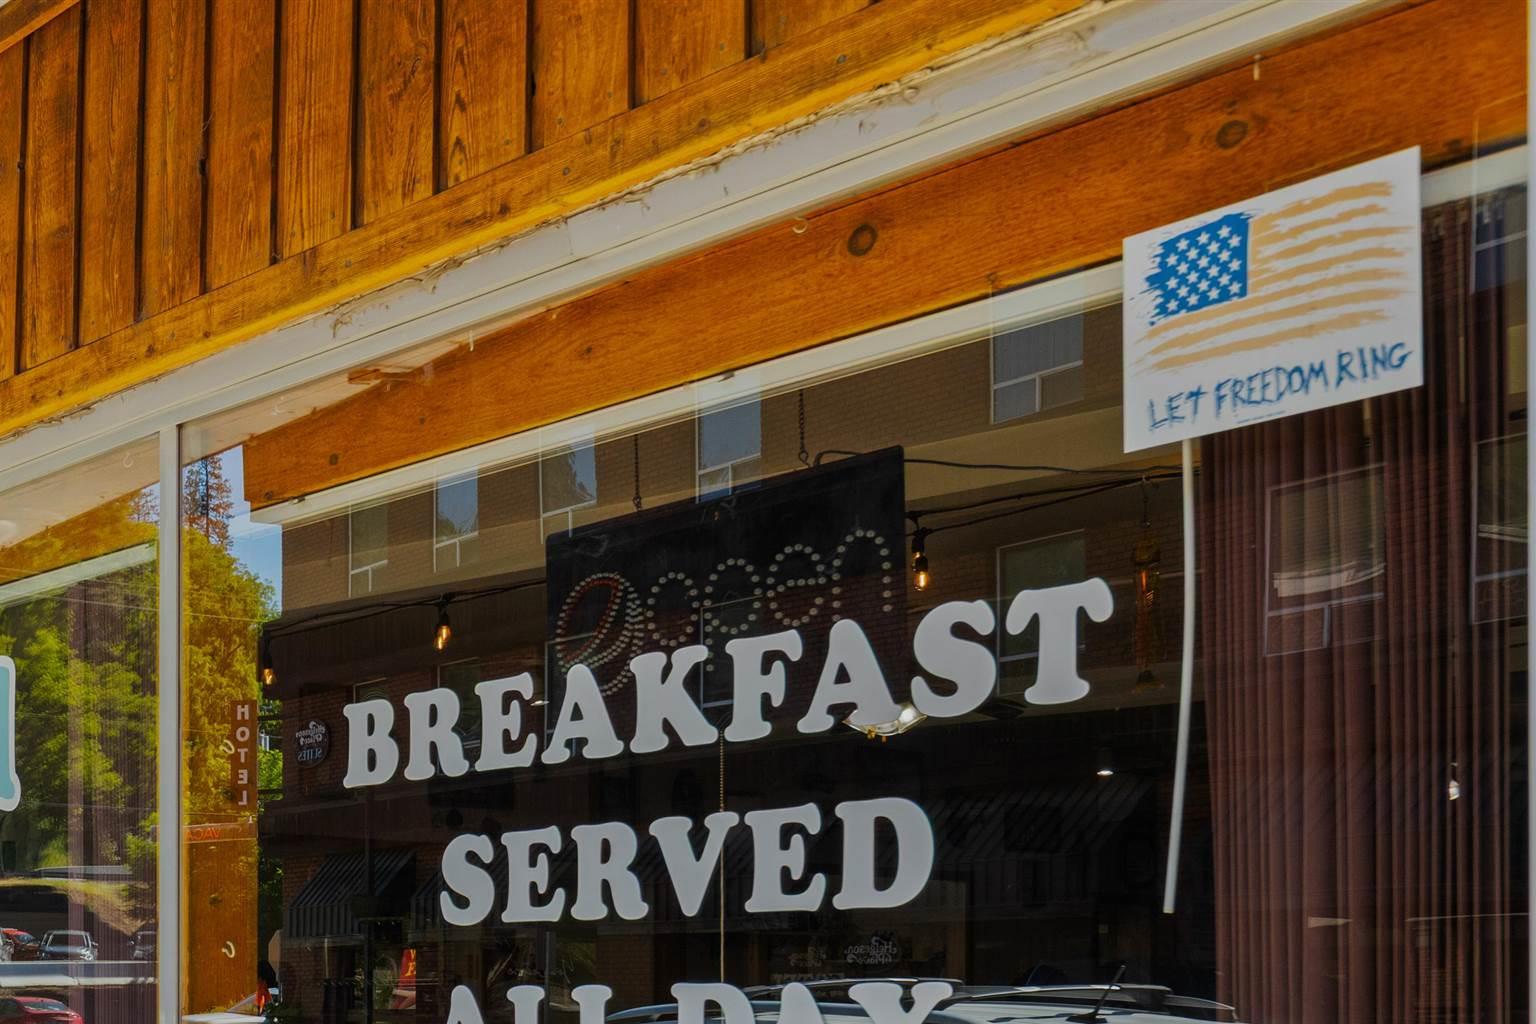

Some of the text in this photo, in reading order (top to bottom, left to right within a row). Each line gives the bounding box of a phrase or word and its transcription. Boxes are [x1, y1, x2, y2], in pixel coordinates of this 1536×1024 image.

[1147, 341, 1413, 432] LET FREEDOM RING
[342, 577, 1115, 790] BREAKFAST
[440, 797, 936, 928] SERVED
